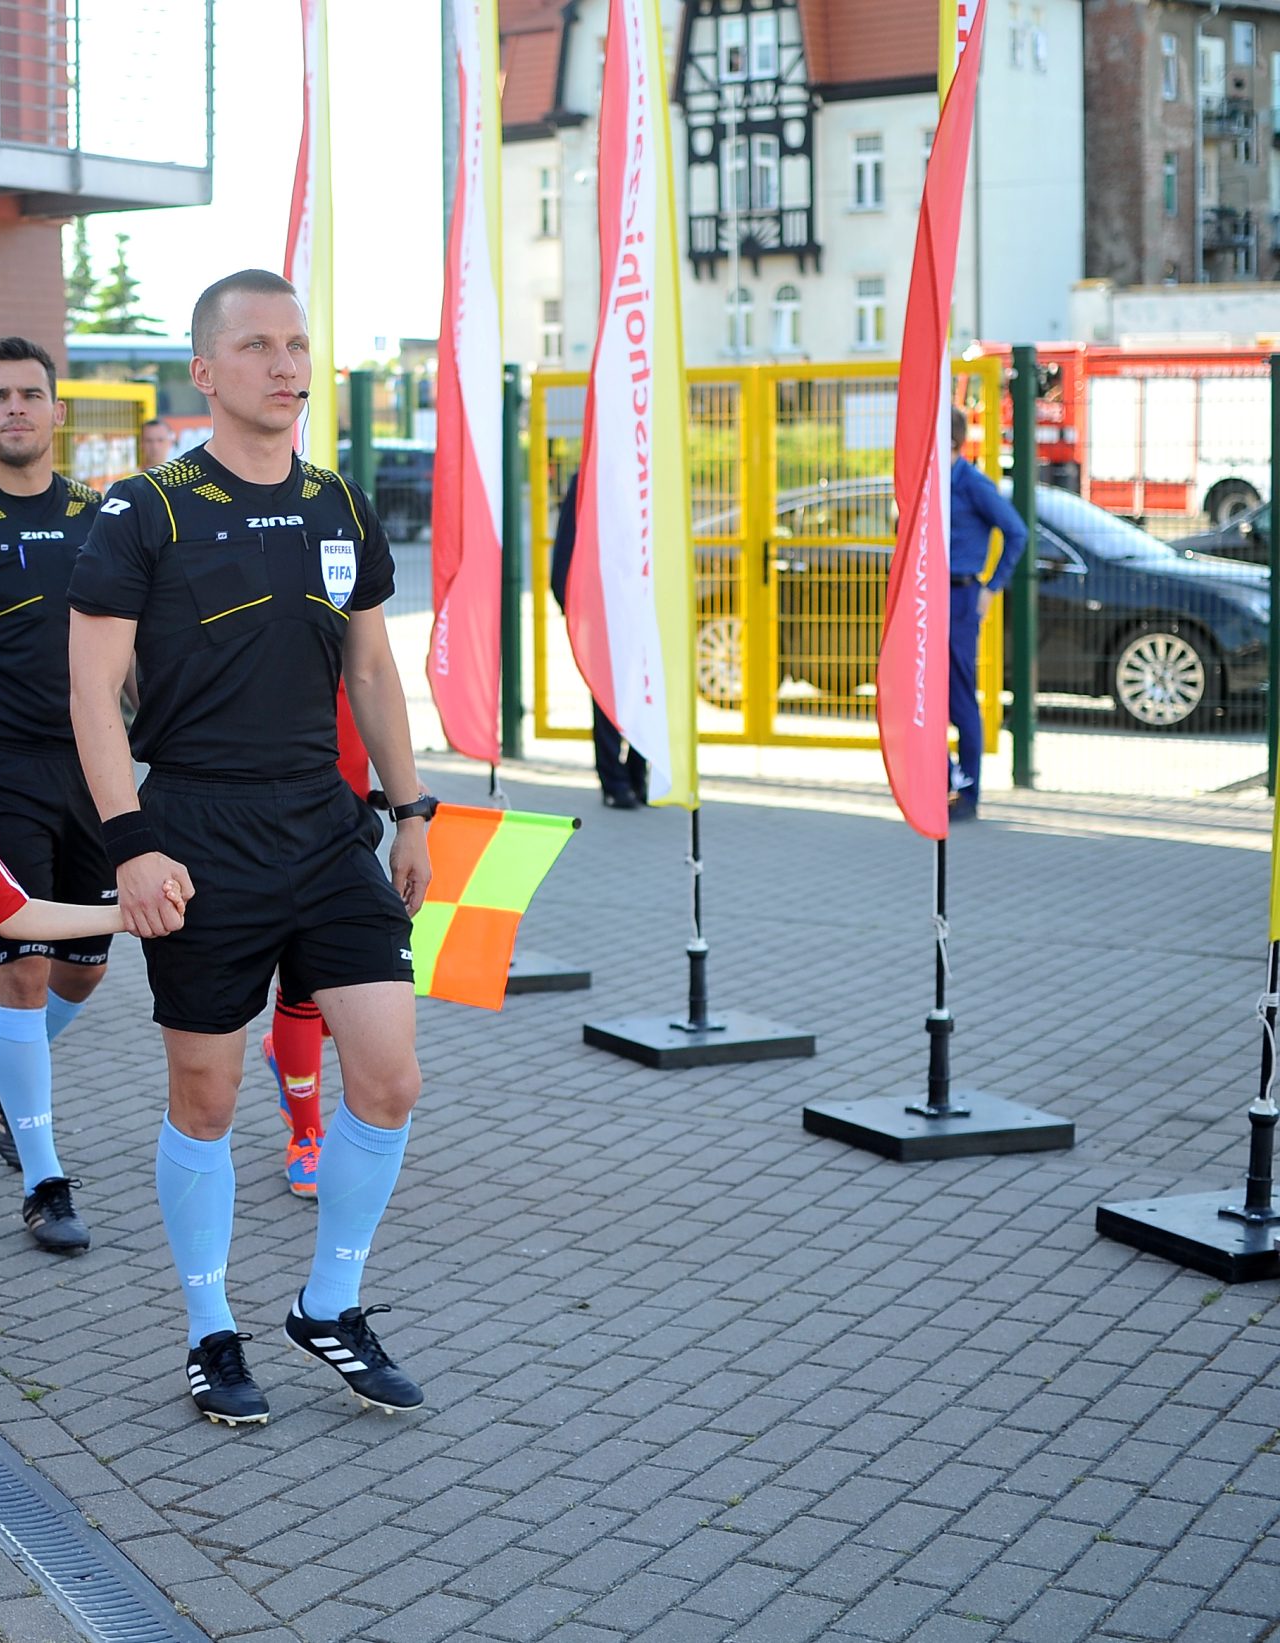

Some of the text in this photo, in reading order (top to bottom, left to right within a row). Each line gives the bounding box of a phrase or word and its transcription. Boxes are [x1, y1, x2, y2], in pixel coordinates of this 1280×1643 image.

[246, 515, 304, 528] zina
[20, 530, 64, 541] zina
[324, 545, 352, 554] REFEREE
[328, 566, 352, 580] FIFA
[17, 1112, 52, 1130] zin
